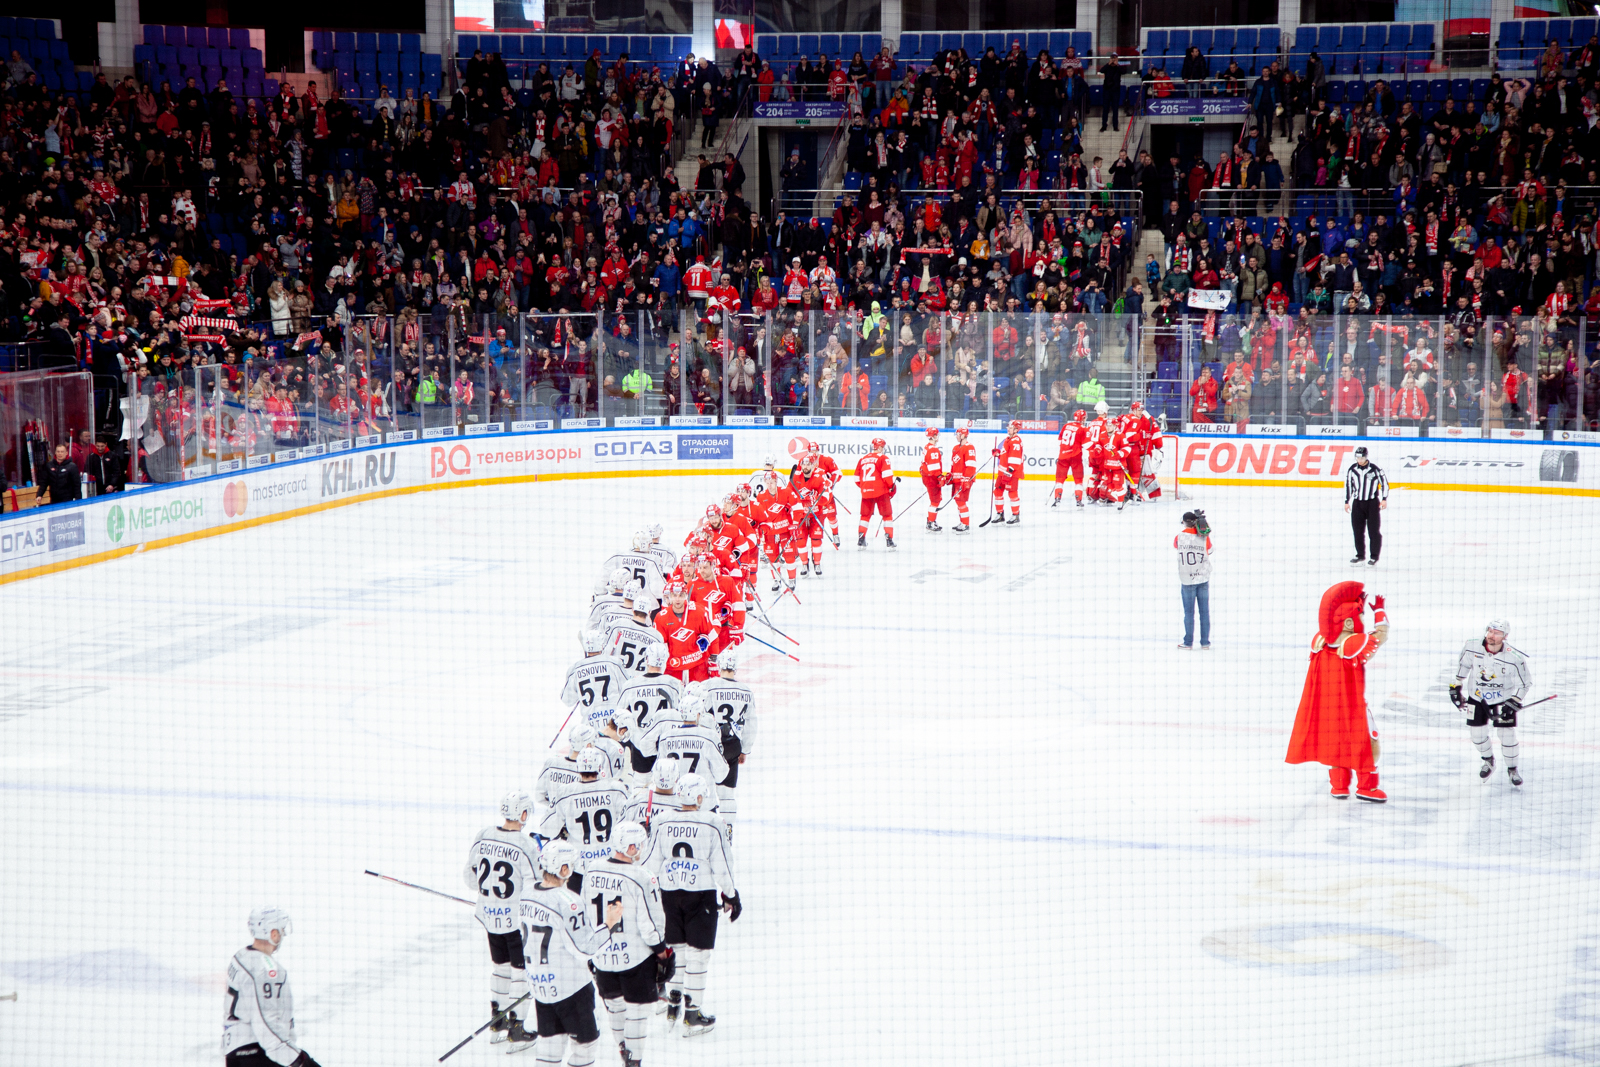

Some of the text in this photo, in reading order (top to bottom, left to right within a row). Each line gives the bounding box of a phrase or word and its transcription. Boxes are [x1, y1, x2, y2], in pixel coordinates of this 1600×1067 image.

[766, 108, 783, 116] 204
[805, 108, 822, 116] 205
[1160, 105, 1179, 114] 205
[1202, 104, 1221, 113] 206
[691, 272, 701, 287] 11
[1192, 424, 1231, 433] KHL.RU
[1061, 429, 1076, 446] 91
[594, 440, 673, 456] СОГАЗ
[689, 447, 721, 455] ГРУППА
[430, 444, 582, 478] BQ телевизоры
[1024, 454, 1059, 467] ОСТ
[1182, 442, 1354, 476] FONBET
[1435, 459, 1525, 468] NITTO
[321, 451, 397, 497] KHL.RU
[861, 463, 876, 482] 12
[252, 475, 307, 501] mastercard
[51, 518, 82, 533] СТРАХОВАЯ
[55, 532, 78, 543] ГРУППА
[622, 558, 646, 567] SALIMOV
[1179, 551, 1205, 566] 107
[577, 664, 608, 679] OSNOVIN
[578, 675, 611, 707] 57
[1482, 691, 1503, 700] ЮГК
[667, 752, 700, 773] 7
[501, 804, 509, 812] 23
[574, 794, 612, 809] THOMAS
[575, 808, 613, 844] 19
[667, 826, 699, 838] POPOV
[478, 857, 515, 899] 23
[590, 876, 624, 892] SEDLAK
[569, 910, 586, 932] 27
[263, 982, 284, 999] 97
